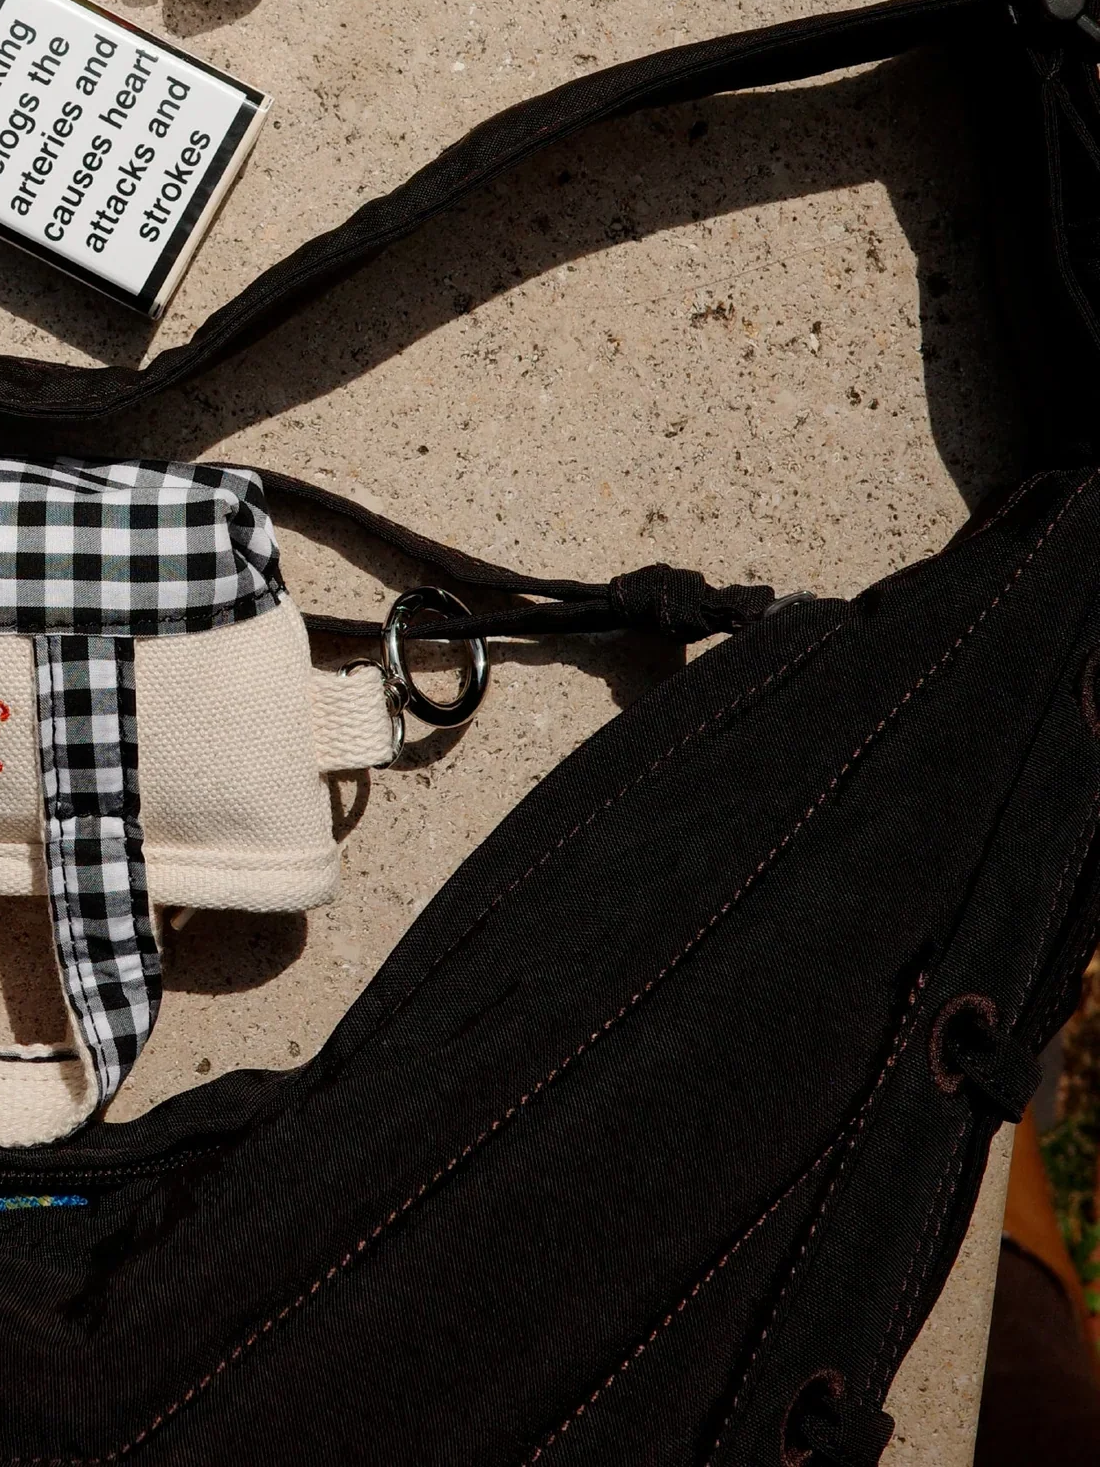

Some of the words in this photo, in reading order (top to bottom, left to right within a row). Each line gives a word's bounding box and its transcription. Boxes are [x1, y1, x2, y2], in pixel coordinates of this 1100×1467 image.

[11, 102, 82, 215] arteries
[76, 34, 117, 95] and
[28, 37, 69, 85] the
[44, 136, 112, 241] causes
[99, 49, 158, 129] heart
[86, 144, 155, 253] attacks
[149, 76, 190, 138] and
[140, 131, 210, 242] strokes
